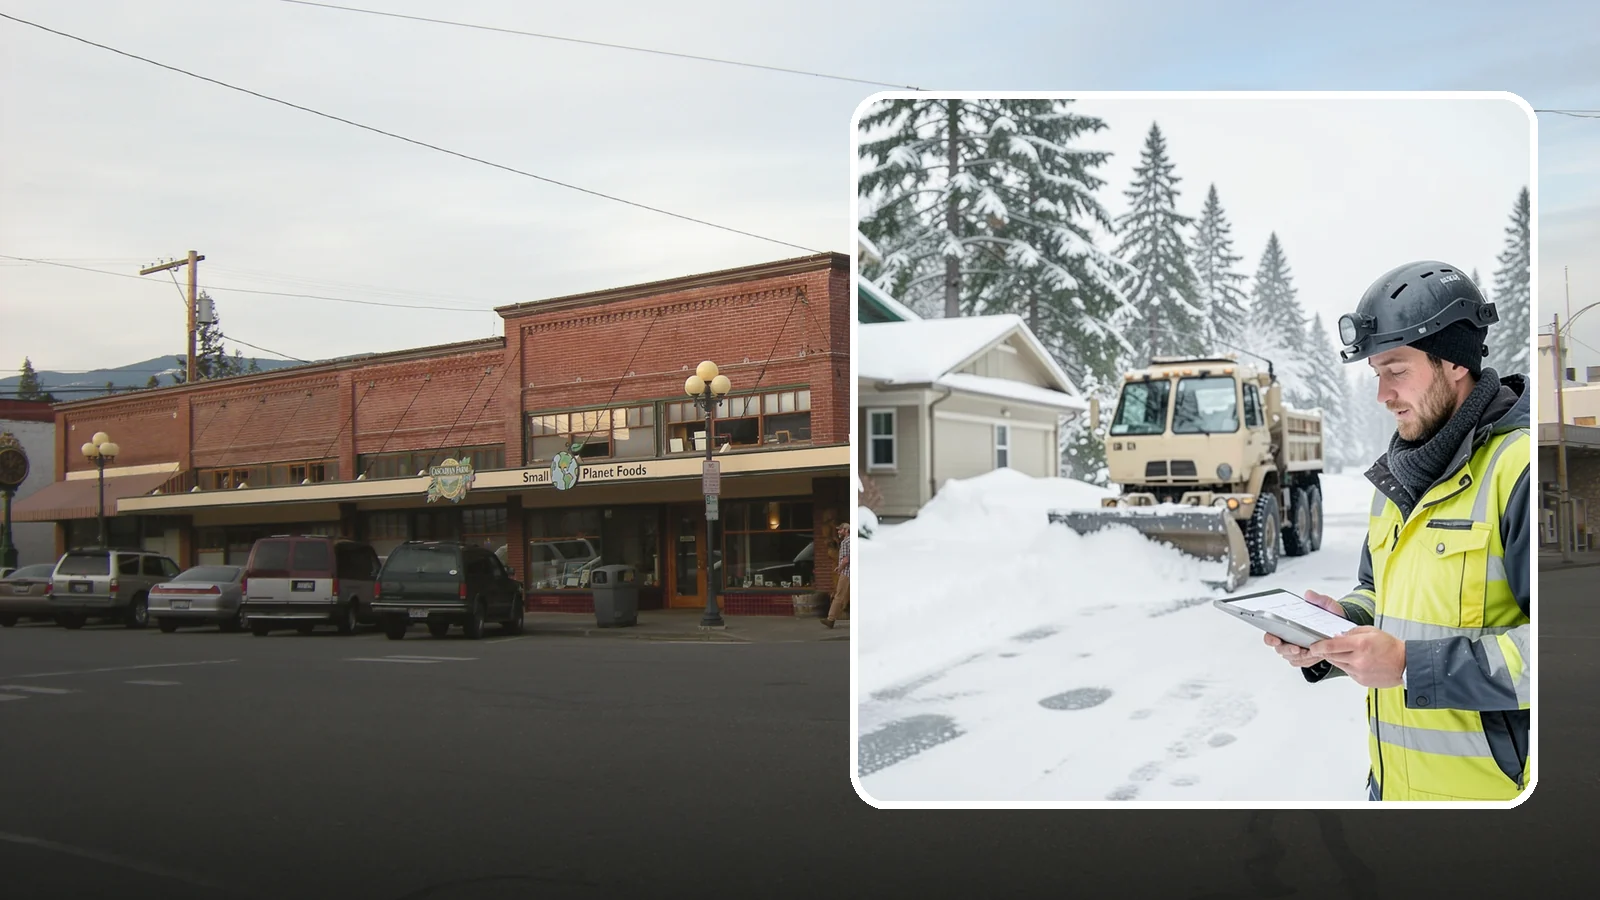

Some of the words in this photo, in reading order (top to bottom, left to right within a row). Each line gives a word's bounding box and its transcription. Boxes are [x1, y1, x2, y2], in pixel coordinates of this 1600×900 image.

[431, 467, 455, 476] CASCADIAN
[456, 466, 469, 474] FARM
[523, 471, 549, 482] Small
[583, 467, 614, 479] Planet
[617, 464, 647, 477] Foods
